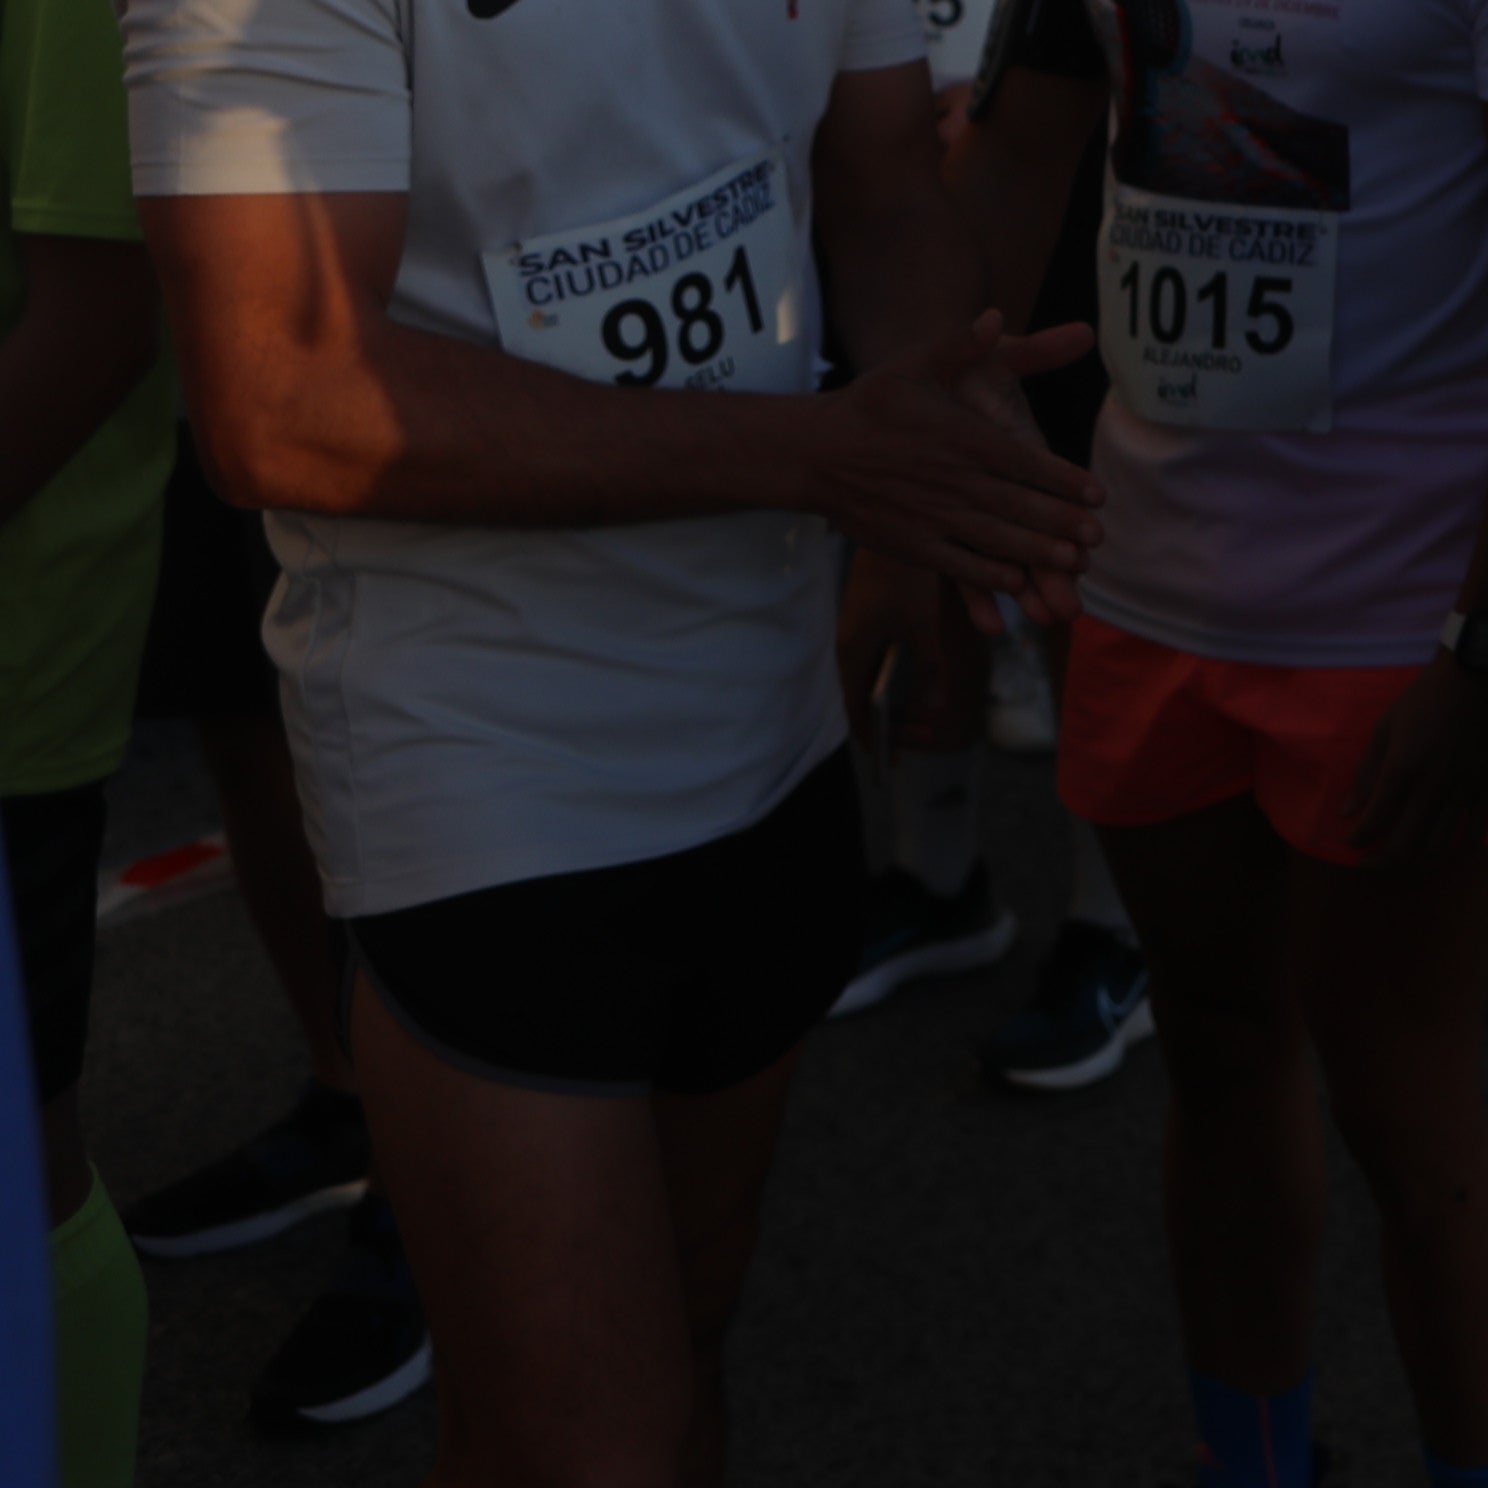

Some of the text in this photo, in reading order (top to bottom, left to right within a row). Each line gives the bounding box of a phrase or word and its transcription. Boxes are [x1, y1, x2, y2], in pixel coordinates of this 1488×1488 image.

[518, 160, 770, 277] SAN SILVESTRE
[1155, 208, 1318, 240] SILVESTRE
[1188, 230, 1220, 258] DE
[525, 244, 670, 306] CIUDAD
[672, 228, 713, 260] DE
[602, 244, 763, 386] 981
[1120, 260, 1294, 355] 1015
[1143, 347, 1243, 375] ALEJANDRO
